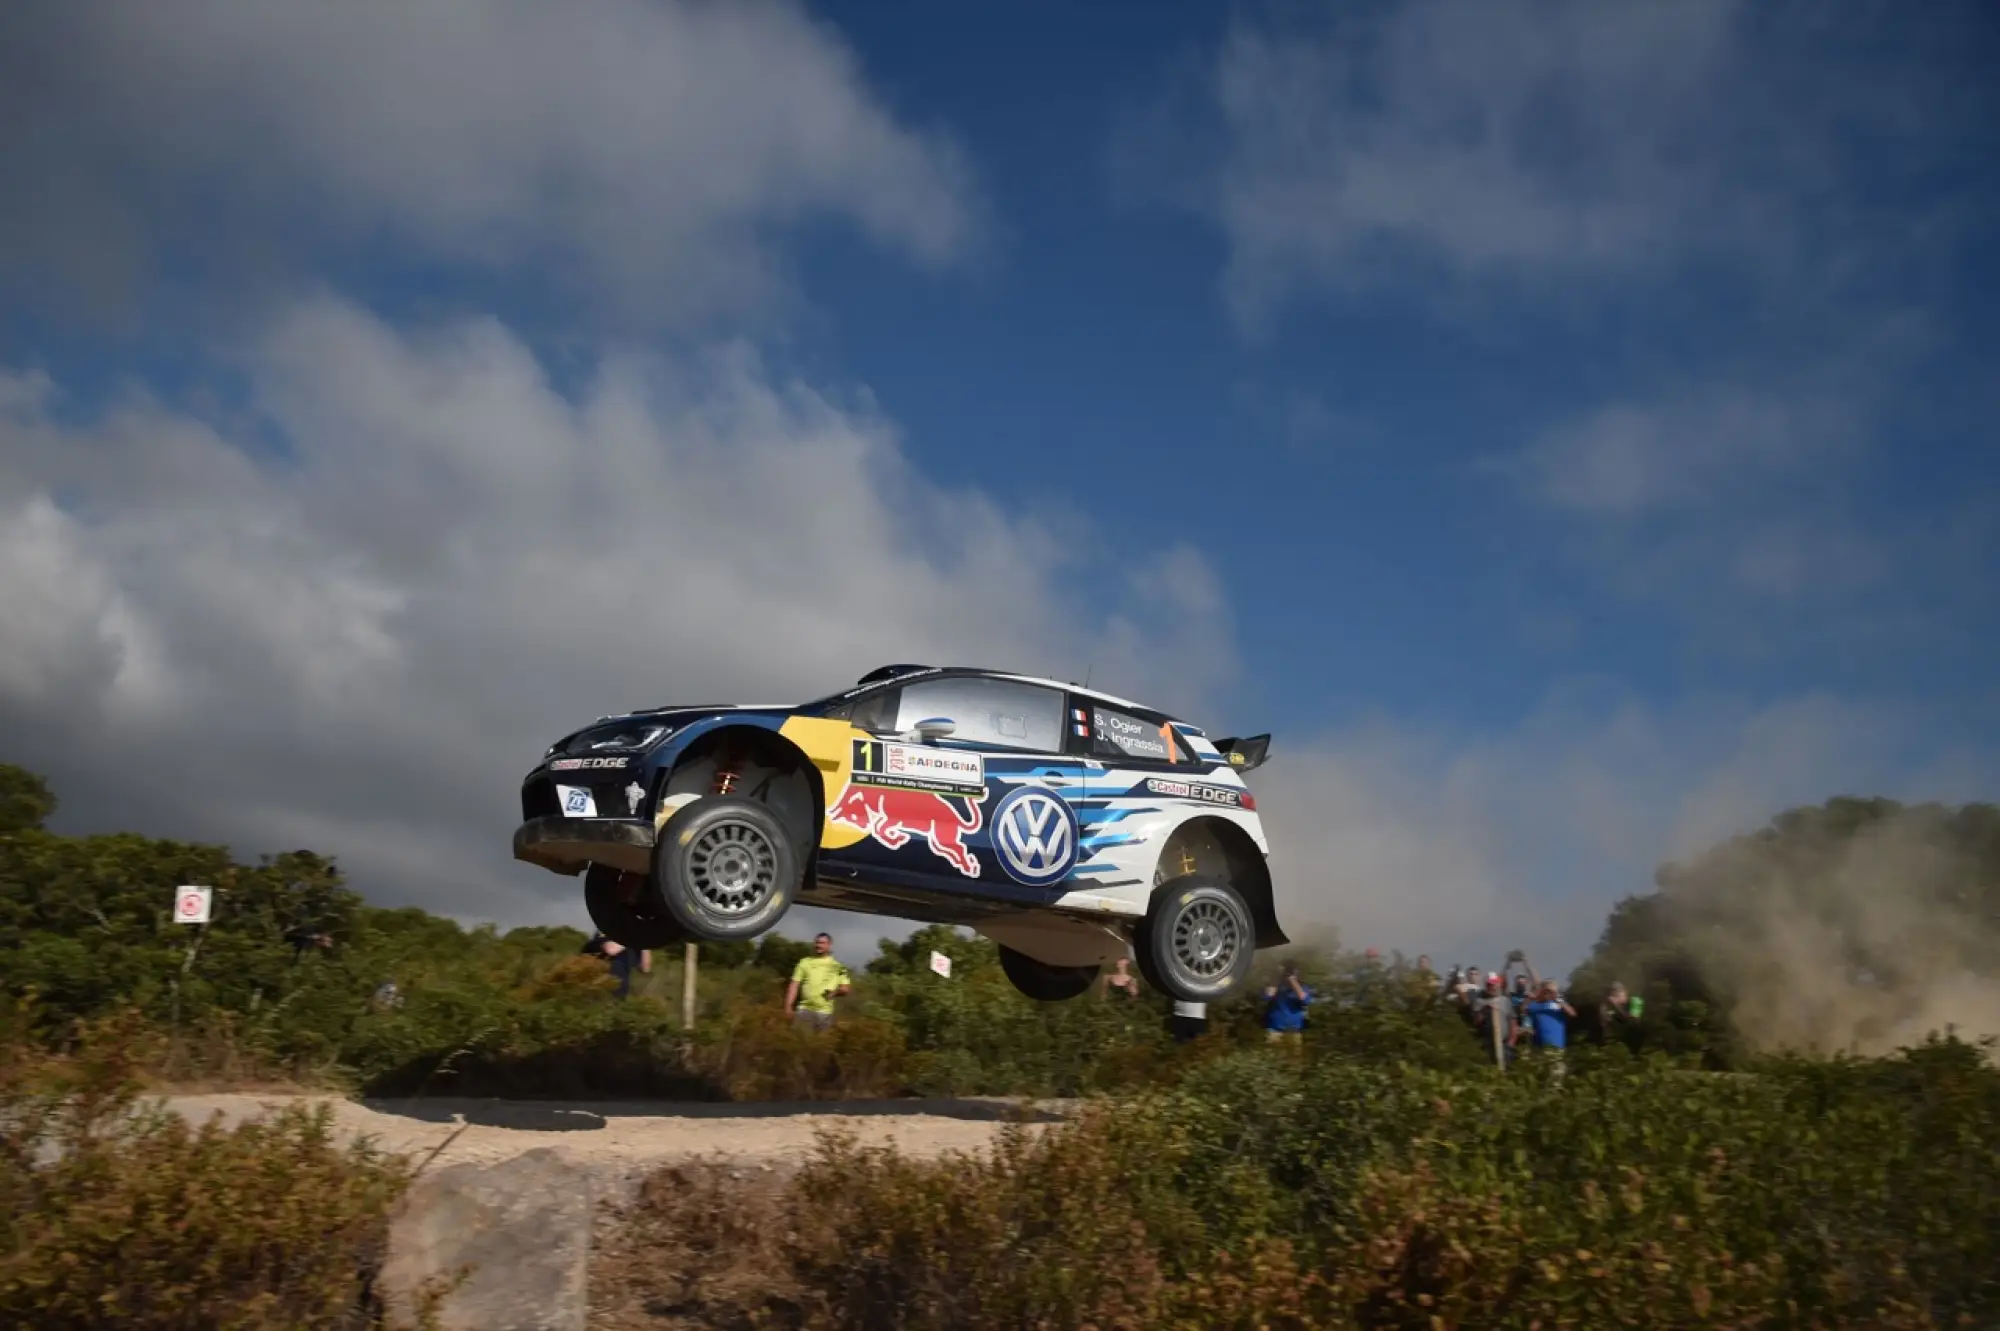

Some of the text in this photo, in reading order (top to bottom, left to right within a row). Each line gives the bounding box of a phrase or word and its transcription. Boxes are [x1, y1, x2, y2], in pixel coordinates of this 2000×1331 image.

[1094, 713, 1142, 733] S. Ogier
[1097, 729, 1164, 753] J. Ingrassia
[1158, 722, 1176, 764] 1
[582, 757, 630, 768] EDGE
[860, 741, 872, 771] 1
[889, 747, 905, 771] 2016
[907, 756, 979, 773] SARDEGNA
[1157, 782, 1238, 805] Castrol EDGE
[998, 793, 1073, 877] VW
